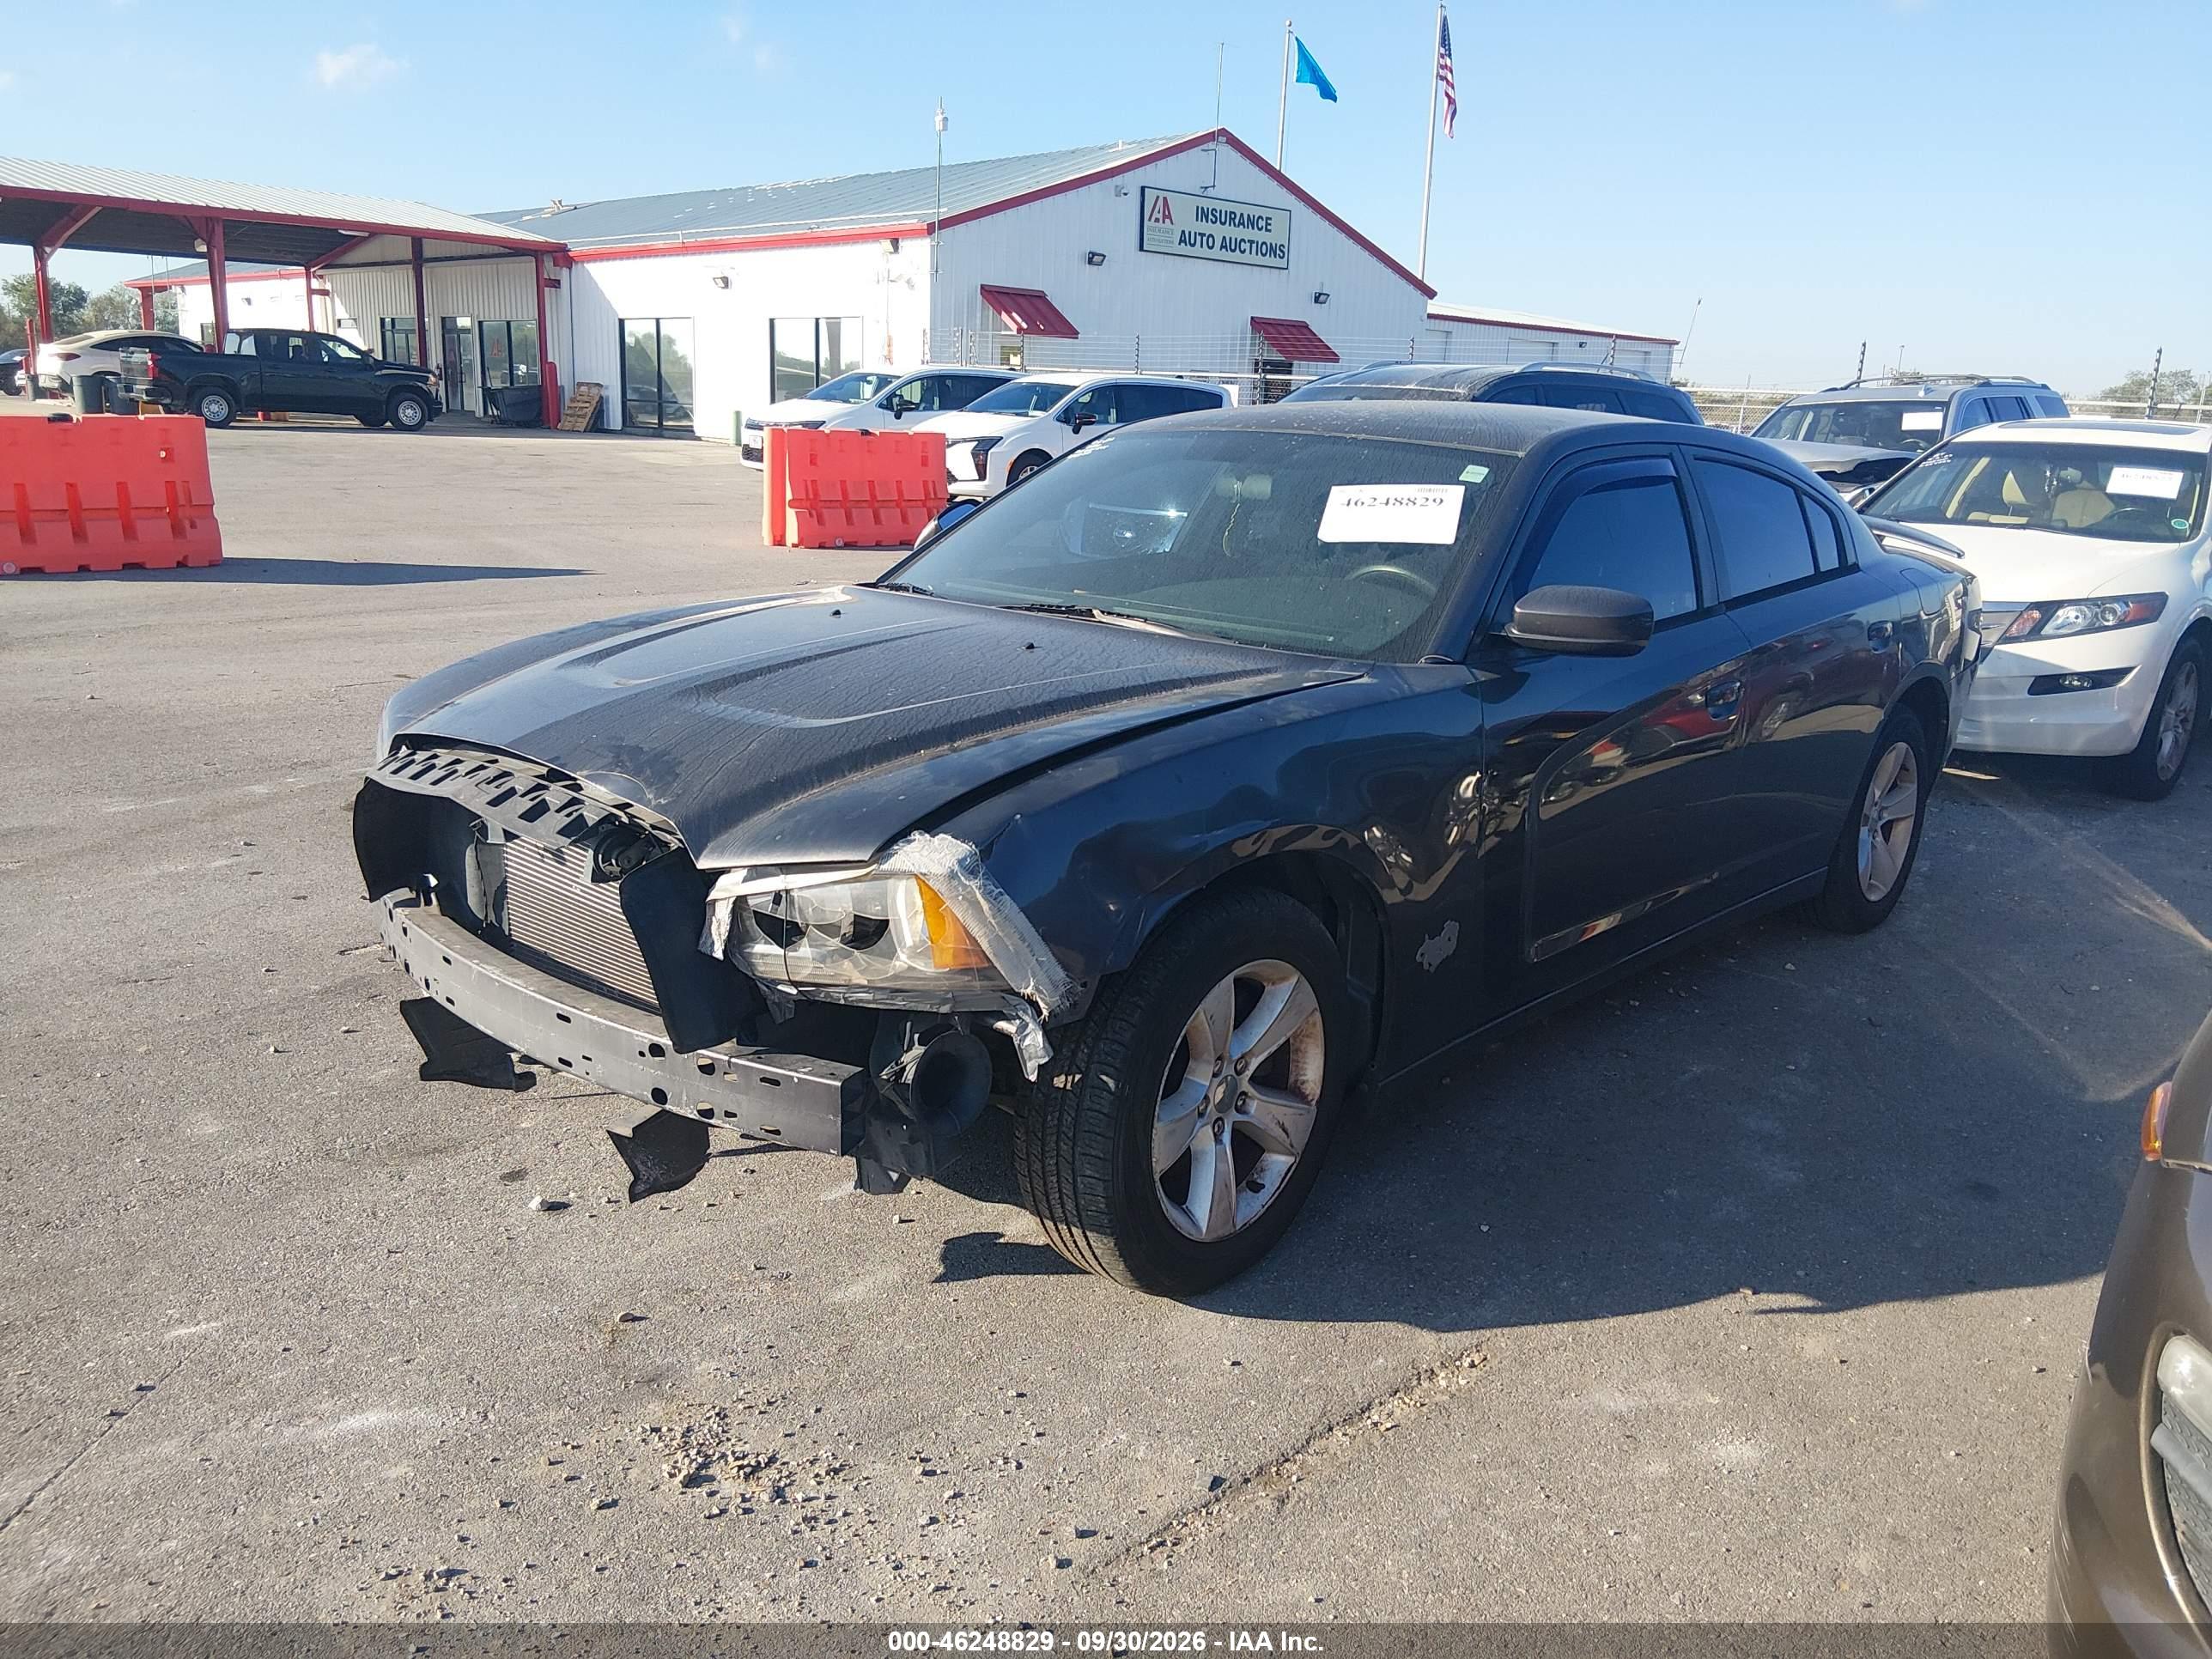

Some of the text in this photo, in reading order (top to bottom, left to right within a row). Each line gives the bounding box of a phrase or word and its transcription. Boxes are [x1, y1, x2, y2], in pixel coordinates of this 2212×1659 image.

[1195, 205, 1273, 233] INSURANCE
[1178, 229, 1216, 250] AUTO
[1219, 235, 1285, 259] AUCTIONS
[1340, 496, 1444, 507] 46248829
